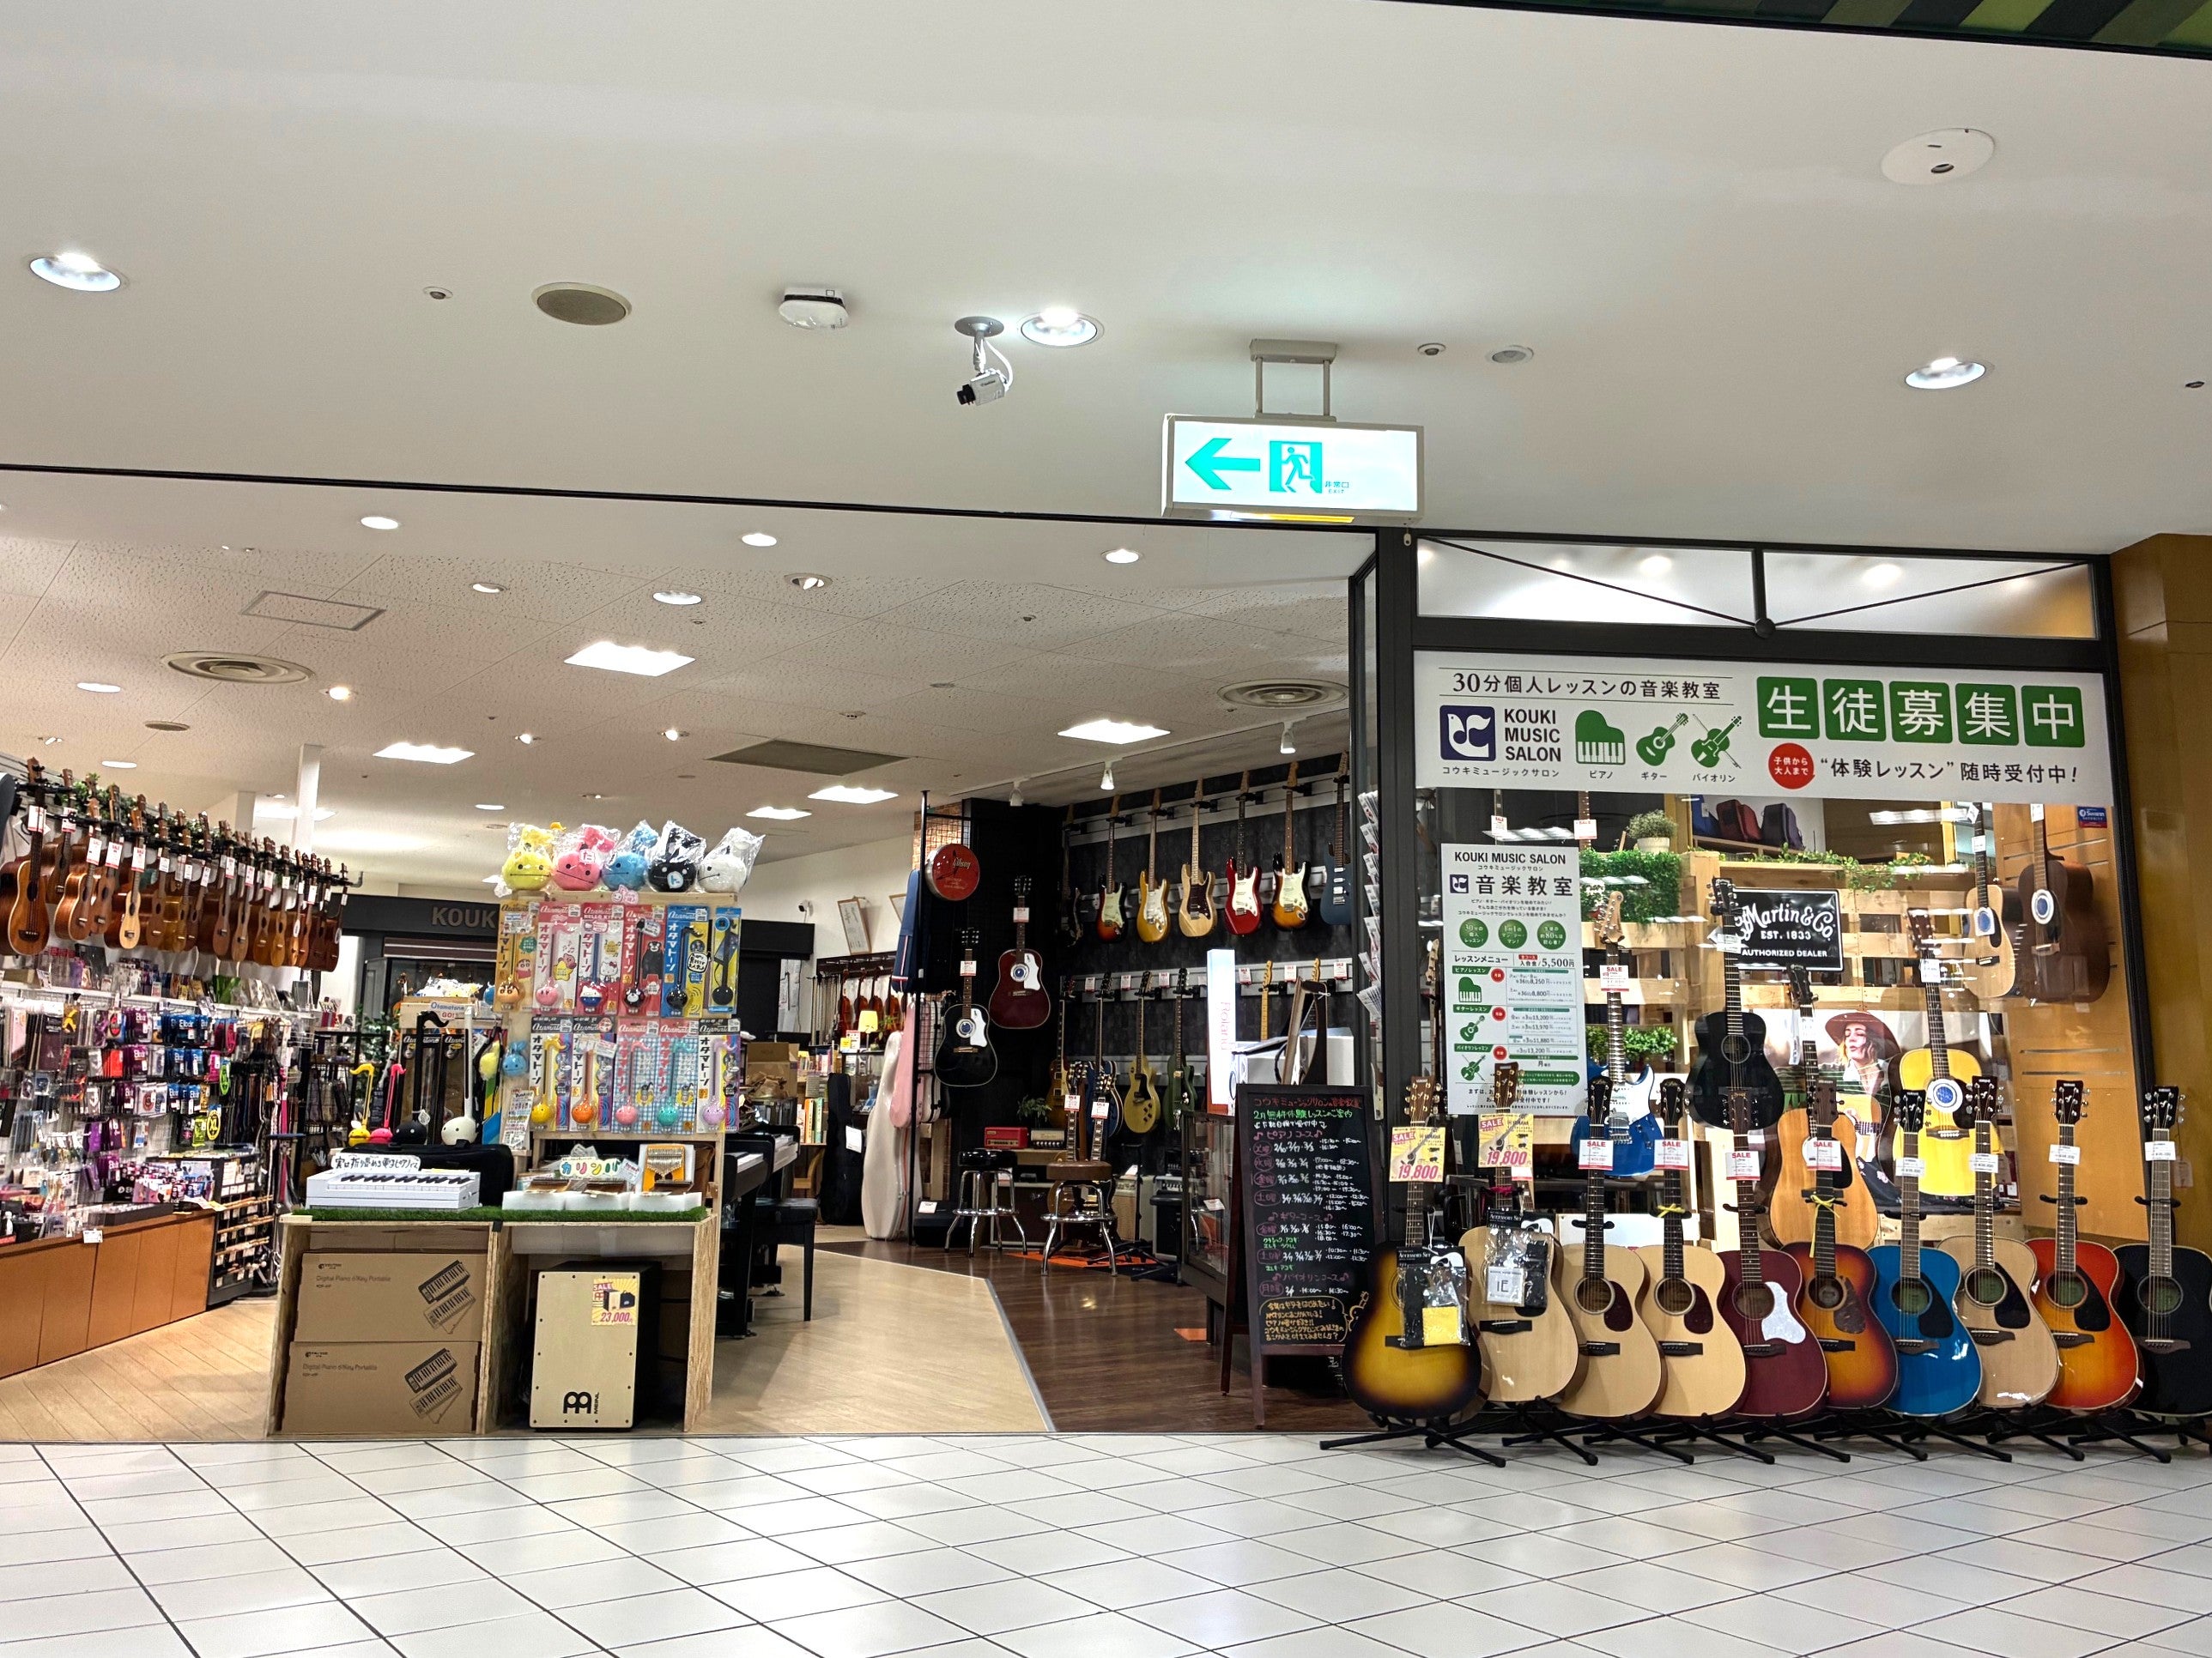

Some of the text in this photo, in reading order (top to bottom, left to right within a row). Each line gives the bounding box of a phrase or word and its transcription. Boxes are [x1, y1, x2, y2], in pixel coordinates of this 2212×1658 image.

[1452, 673, 1721, 700] 30分個人レッスンの音楽教室
[1504, 708, 1556, 724] KOUKI
[1766, 684, 2076, 740] 生徒募集中
[1505, 727, 1561, 743] MUSIC
[1505, 746, 1561, 762] SALON
[1773, 756, 1809, 765] 子供から
[1443, 766, 1560, 778] コウキミュージックサロン
[1589, 770, 1614, 779] ピアノ
[1641, 772, 1668, 781] ギター
[1692, 773, 1736, 783] バイオリン
[1774, 766, 1809, 776] 大人まで
[1454, 851, 1567, 864] KOUKI MUSIC SALON
[1476, 874, 1573, 896] 音楽教室
[431, 906, 497, 929] KOUK
[1761, 930, 1812, 941] EST. 1833
[537, 924, 549, 973] オタマトーン
[582, 934, 593, 972] タマトーン
[625, 923, 636, 972] オタマトーン
[667, 923, 678, 971] オタマトーン
[1742, 948, 1827, 958] AUTHORIZED DEALER
[1454, 955, 1509, 964] レッスンメニュー
[532, 1035, 542, 1085] オタマトーン
[700, 1037, 711, 1086] オタマトーン
[1481, 1118, 1503, 1129] SALE
[1392, 1133, 1415, 1142] SALE
[561, 1161, 620, 1176] カリンバ
